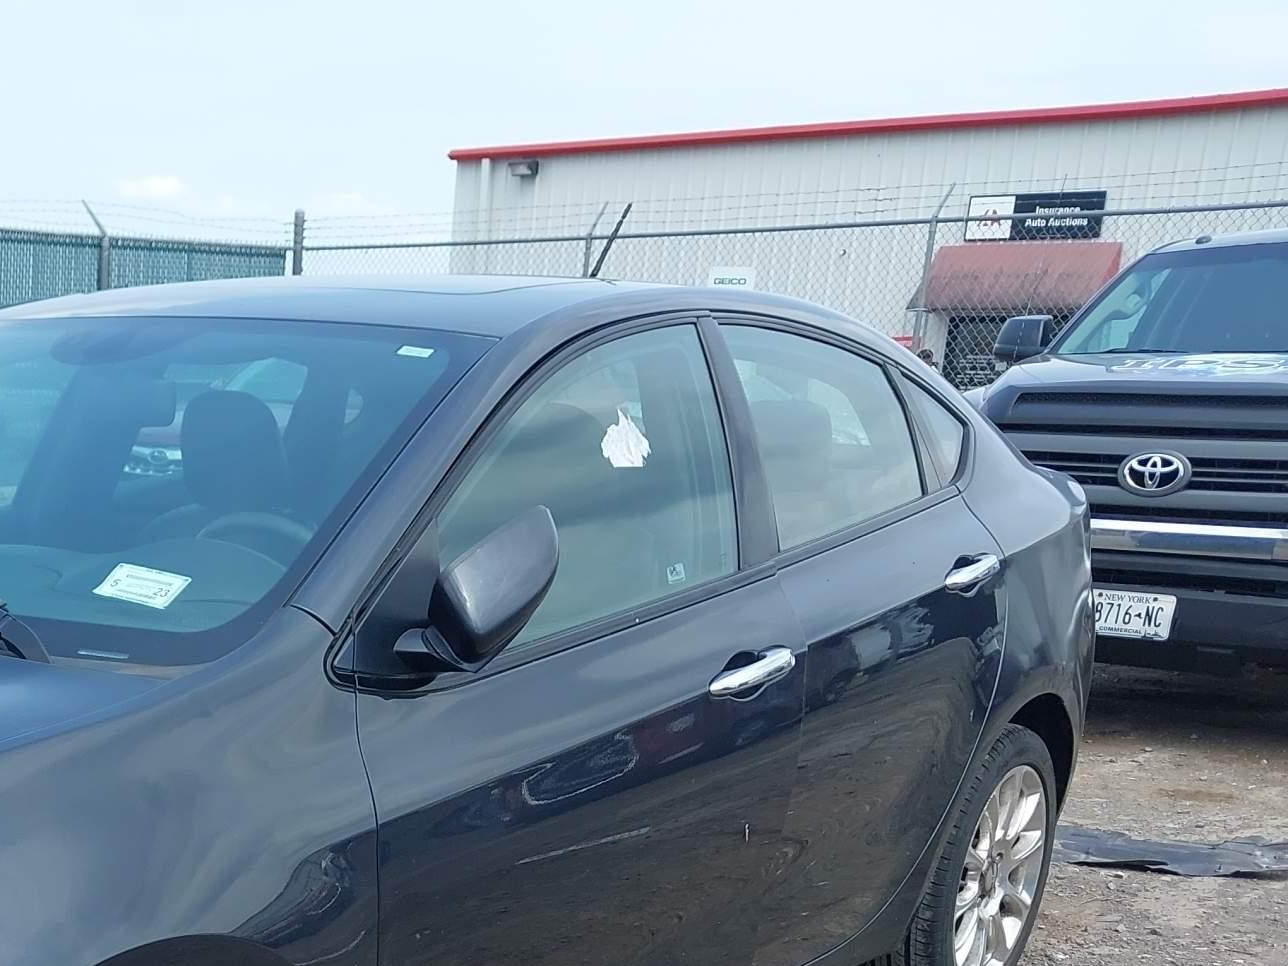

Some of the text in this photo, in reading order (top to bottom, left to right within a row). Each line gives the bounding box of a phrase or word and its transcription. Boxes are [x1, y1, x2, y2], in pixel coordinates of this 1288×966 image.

[1035, 205, 1081, 216] Insurance
[1024, 217, 1088, 227] Auto Auctions
[713, 277, 747, 285] GEICO
[153, 587, 171, 598] 23
[1104, 593, 1152, 604] NEW YORK
[1098, 625, 1143, 634] COMMERCIAL
